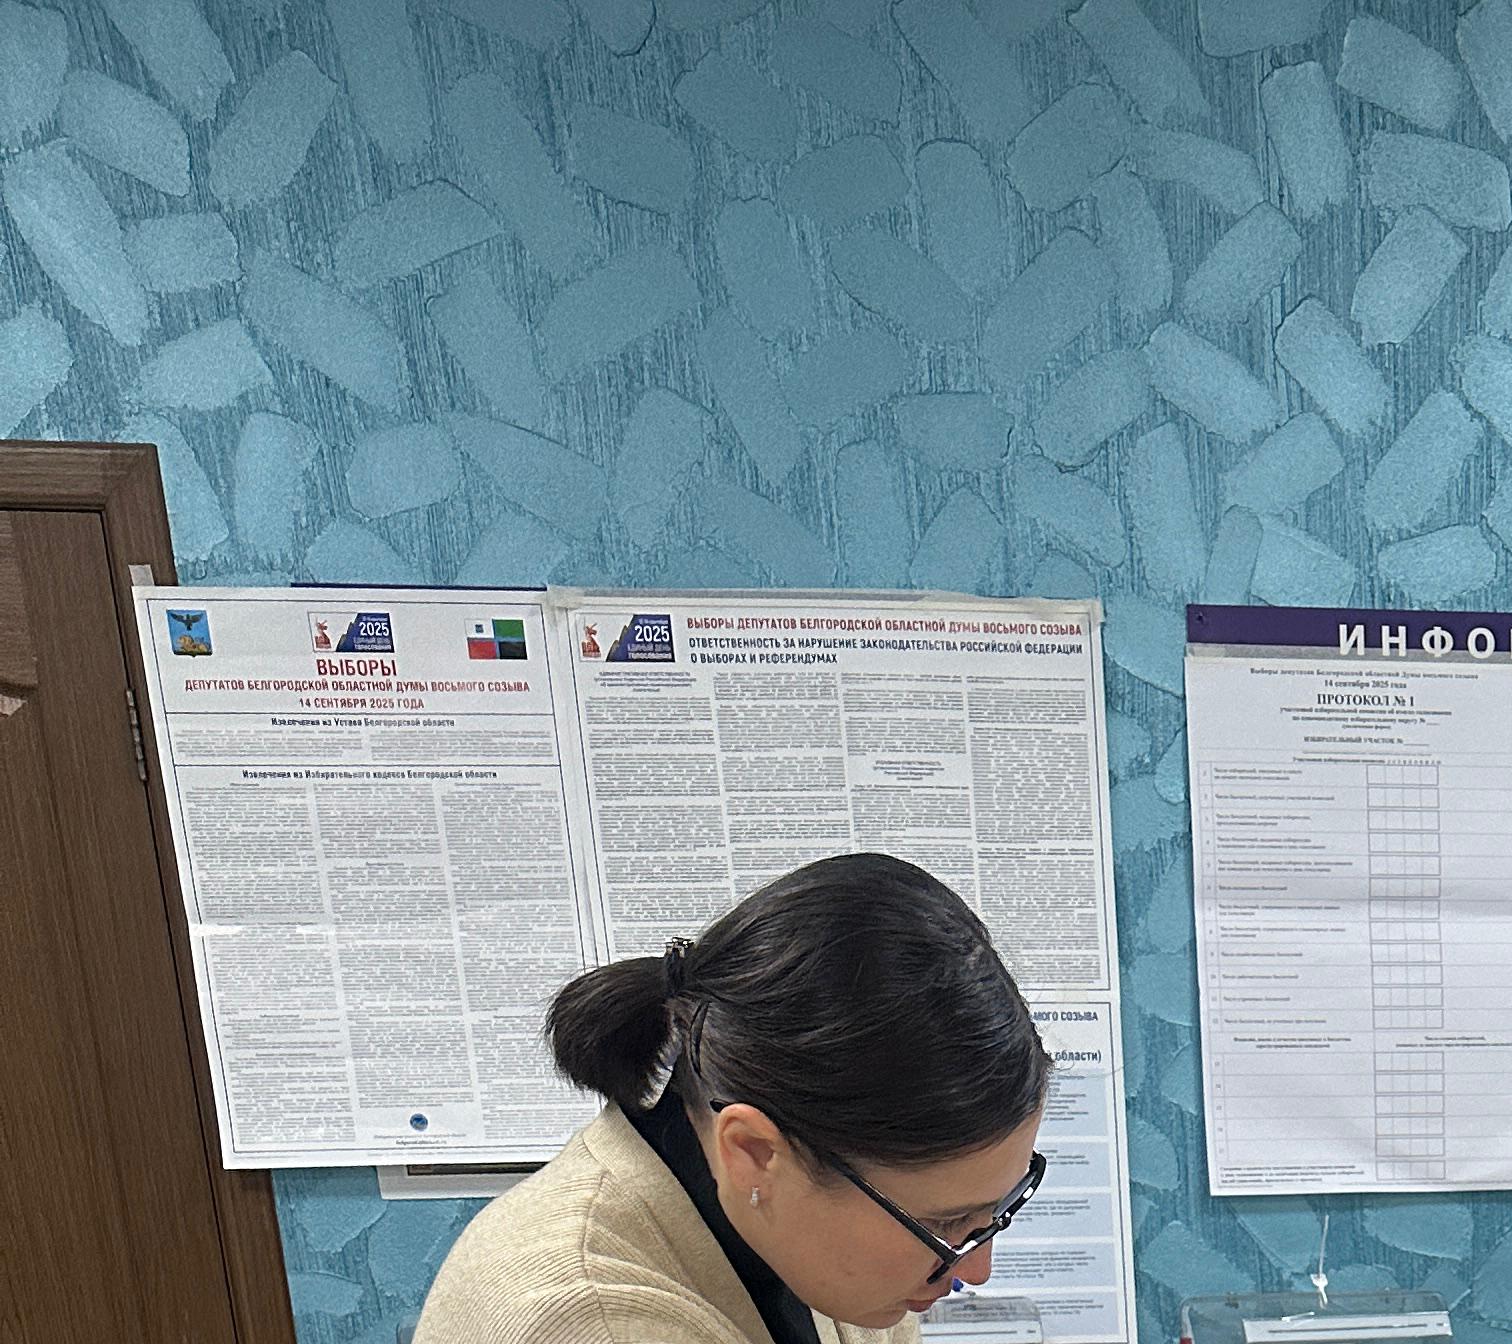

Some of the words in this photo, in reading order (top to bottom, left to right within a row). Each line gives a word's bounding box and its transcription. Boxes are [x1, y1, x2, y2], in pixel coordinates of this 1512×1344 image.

[359, 621, 390, 637] 2025
[634, 625, 670, 642] 2025
[687, 617, 734, 630] ВЫБОРЫ
[737, 617, 797, 631] ДЕПУТАТОВ
[800, 616, 882, 631] БЕЛГОРОДСКОЙ
[885, 617, 946, 633] ОБЛАСТНОЙ
[949, 621, 980, 634] ДУМЫ
[983, 621, 1037, 635] ВОСЬМОГО
[1040, 623, 1082, 636] СОЗЫВА
[688, 637, 781, 649] ОТВЕТСТВЕННОСТЬ
[783, 637, 796, 649] ЗА
[799, 638, 857, 650] НАРУШЕНИЕ
[860, 639, 958, 652] ЗАКОНОДАТЕЛЬСТВА
[960, 640, 1022, 654] РОССИЙСКОЙ
[1024, 642, 1083, 655] ФЕДЕРАЦИИ
[690, 653, 697, 664] О
[700, 653, 747, 665] ВЫБОРАХ
[749, 653, 757, 664] И
[759, 653, 838, 665] РЕФЕРЕНДУМАХ
[316, 658, 397, 677] ВЫБОРЫ
[185, 679, 245, 692] ДЕПУТАТОВ
[248, 679, 329, 693] БЕЛГОРОДСКОЙ
[331, 679, 392, 693] ОБЛАСТНОЙ
[396, 681, 429, 694] ДУМЫ
[431, 681, 485, 693] ВОСЬМОГО
[488, 681, 530, 693] СОЗЫВА
[299, 697, 311, 709] 14
[314, 697, 367, 710] СЕНТЯБРЯ
[369, 698, 395, 710] 2025
[397, 698, 424, 710] ГОДА
[1317, 693, 1390, 707] ПРОТОКОЛ
[1392, 695, 1406, 707] №
[1409, 695, 1415, 707] 1
[1055, 1049, 1102, 1064] области)
